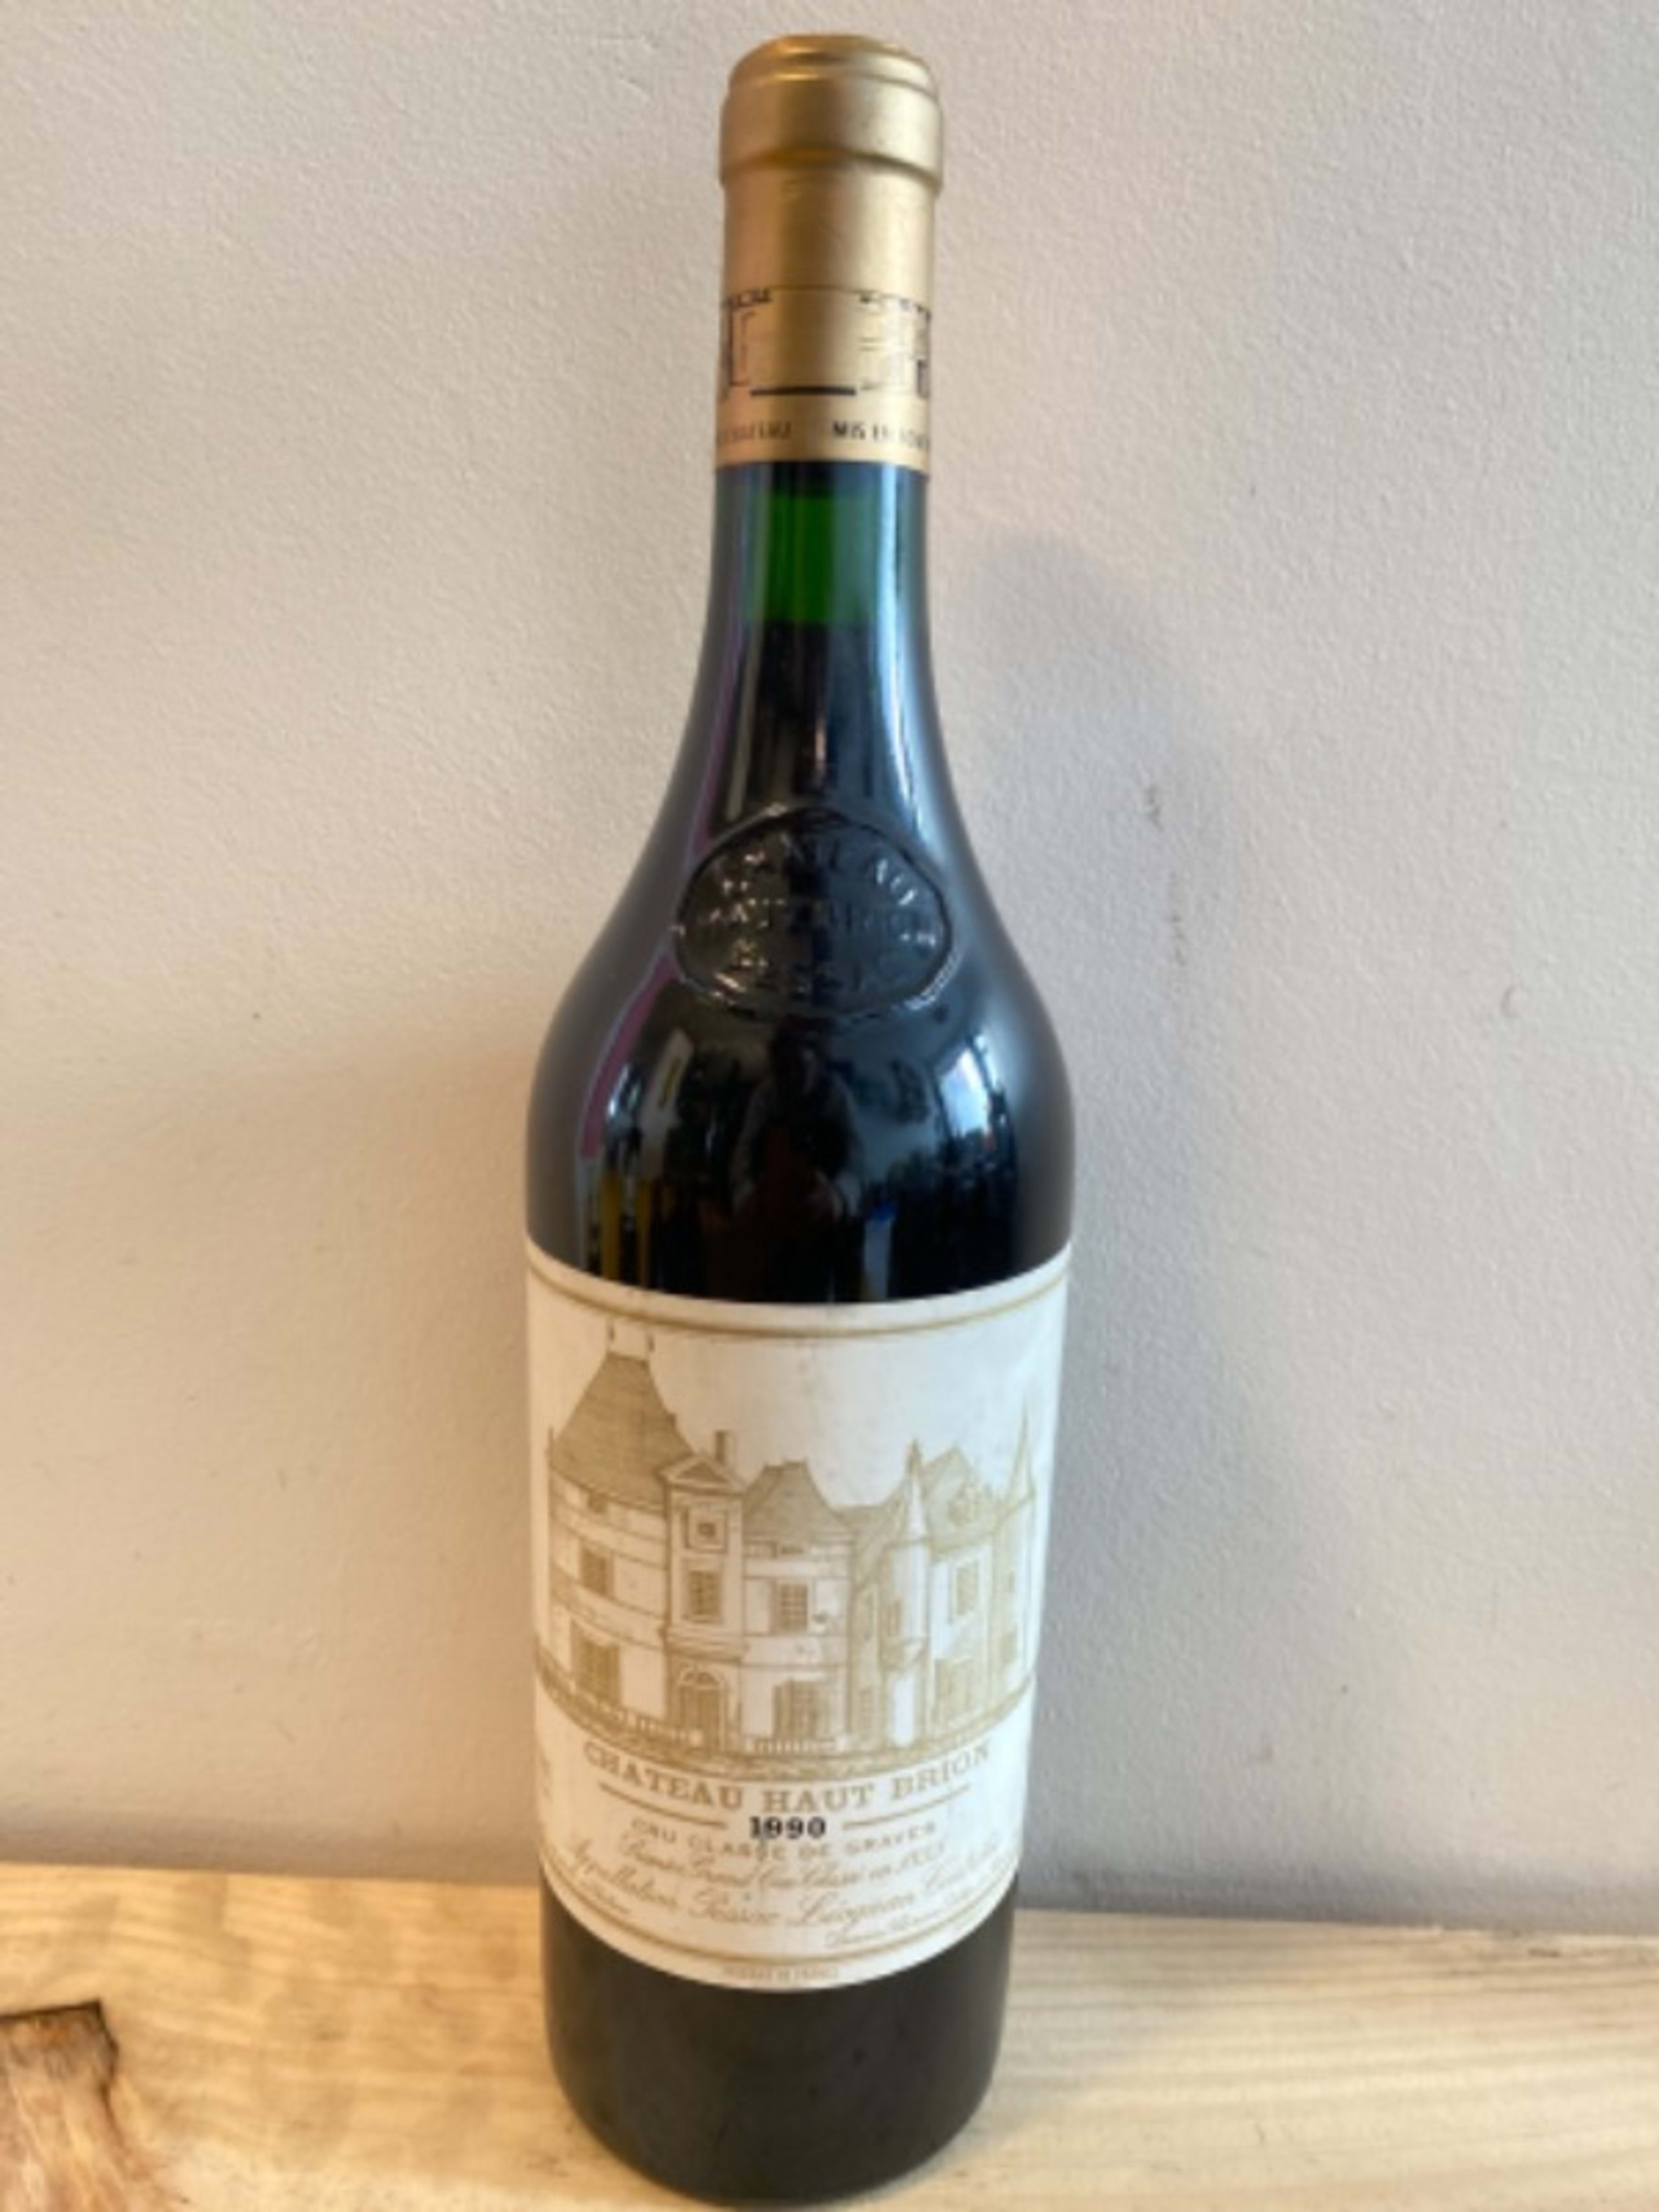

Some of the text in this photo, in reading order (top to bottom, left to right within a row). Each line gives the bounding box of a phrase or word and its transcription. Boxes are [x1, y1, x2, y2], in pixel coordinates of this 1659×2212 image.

[761, 1782, 875, 1813] HAUT
[890, 1745, 990, 1800] BRION
[631, 1817, 677, 1843] CRU
[844, 1821, 937, 1856] GRAVES
[748, 1816, 826, 1840] 1990
